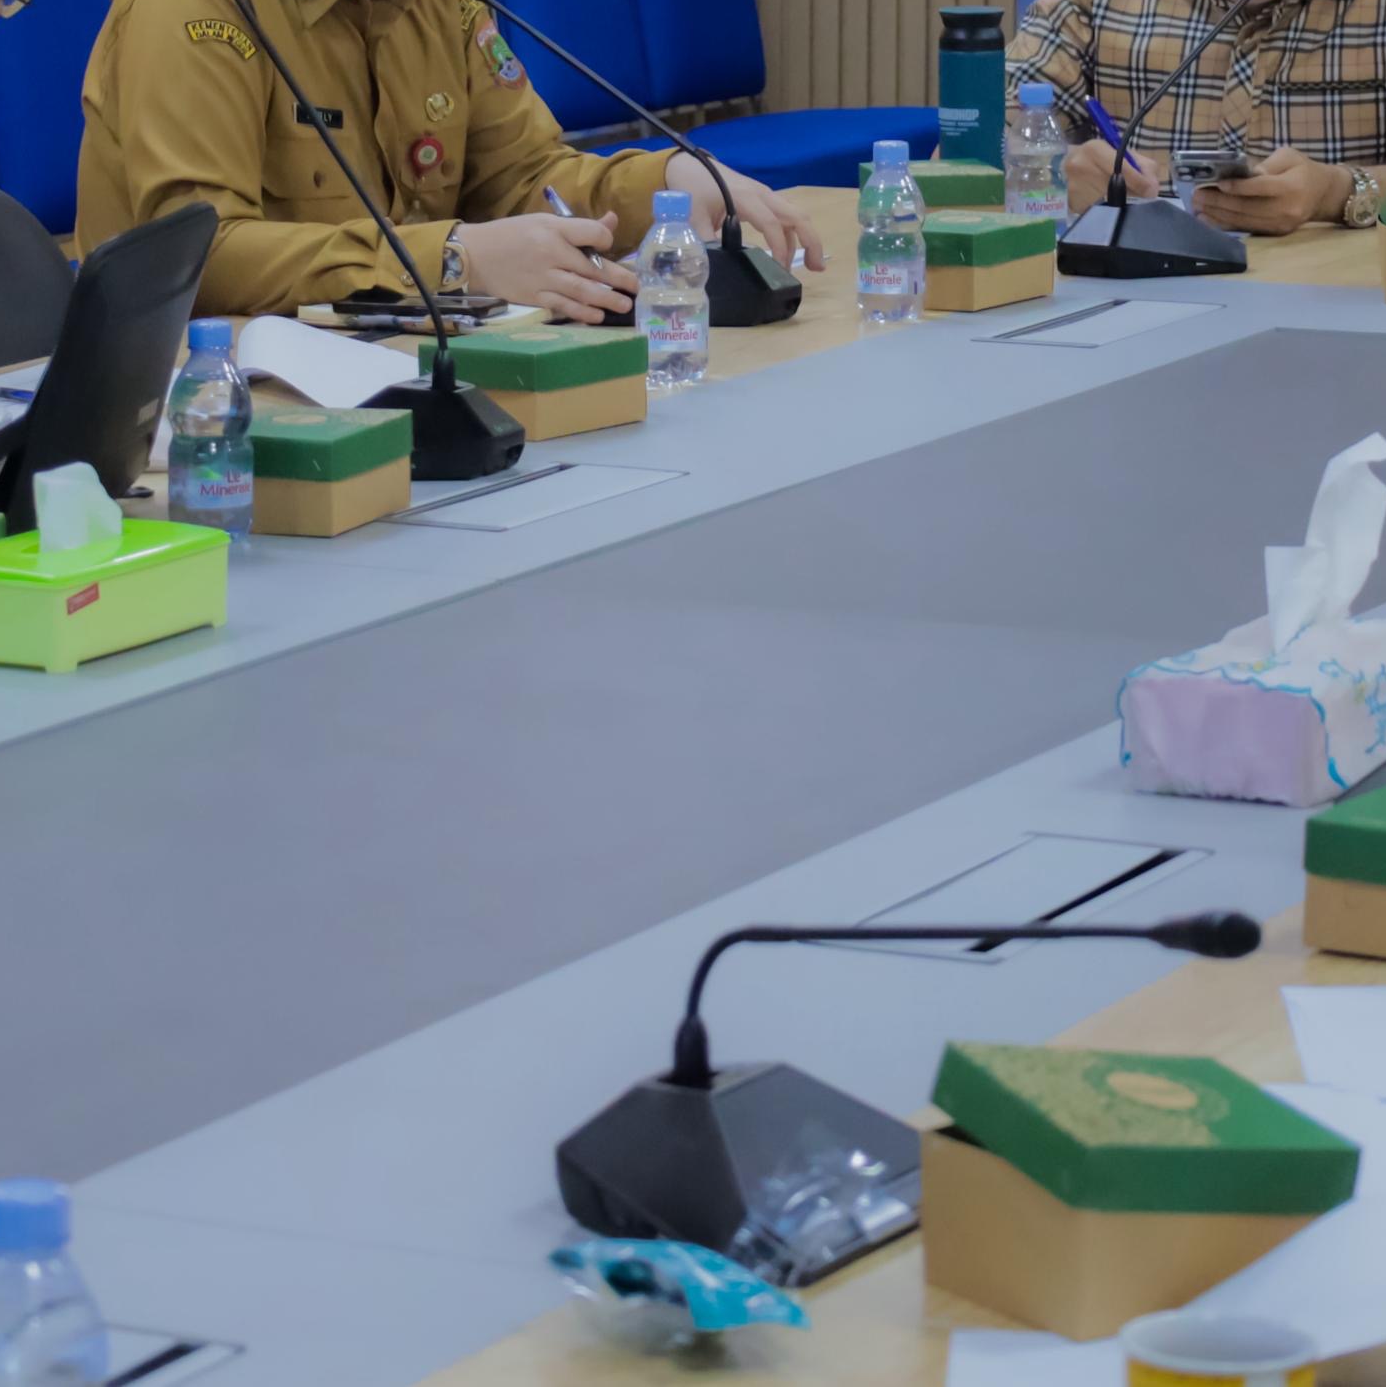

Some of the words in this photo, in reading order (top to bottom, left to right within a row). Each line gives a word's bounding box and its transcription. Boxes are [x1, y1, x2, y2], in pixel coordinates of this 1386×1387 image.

[1045, 191, 1055, 202] Le
[875, 263, 888, 275] Le
[859, 273, 902, 285] Minerale
[671, 316, 686, 331] Le
[650, 329, 698, 341] Minerale
[227, 470, 241, 483] Le
